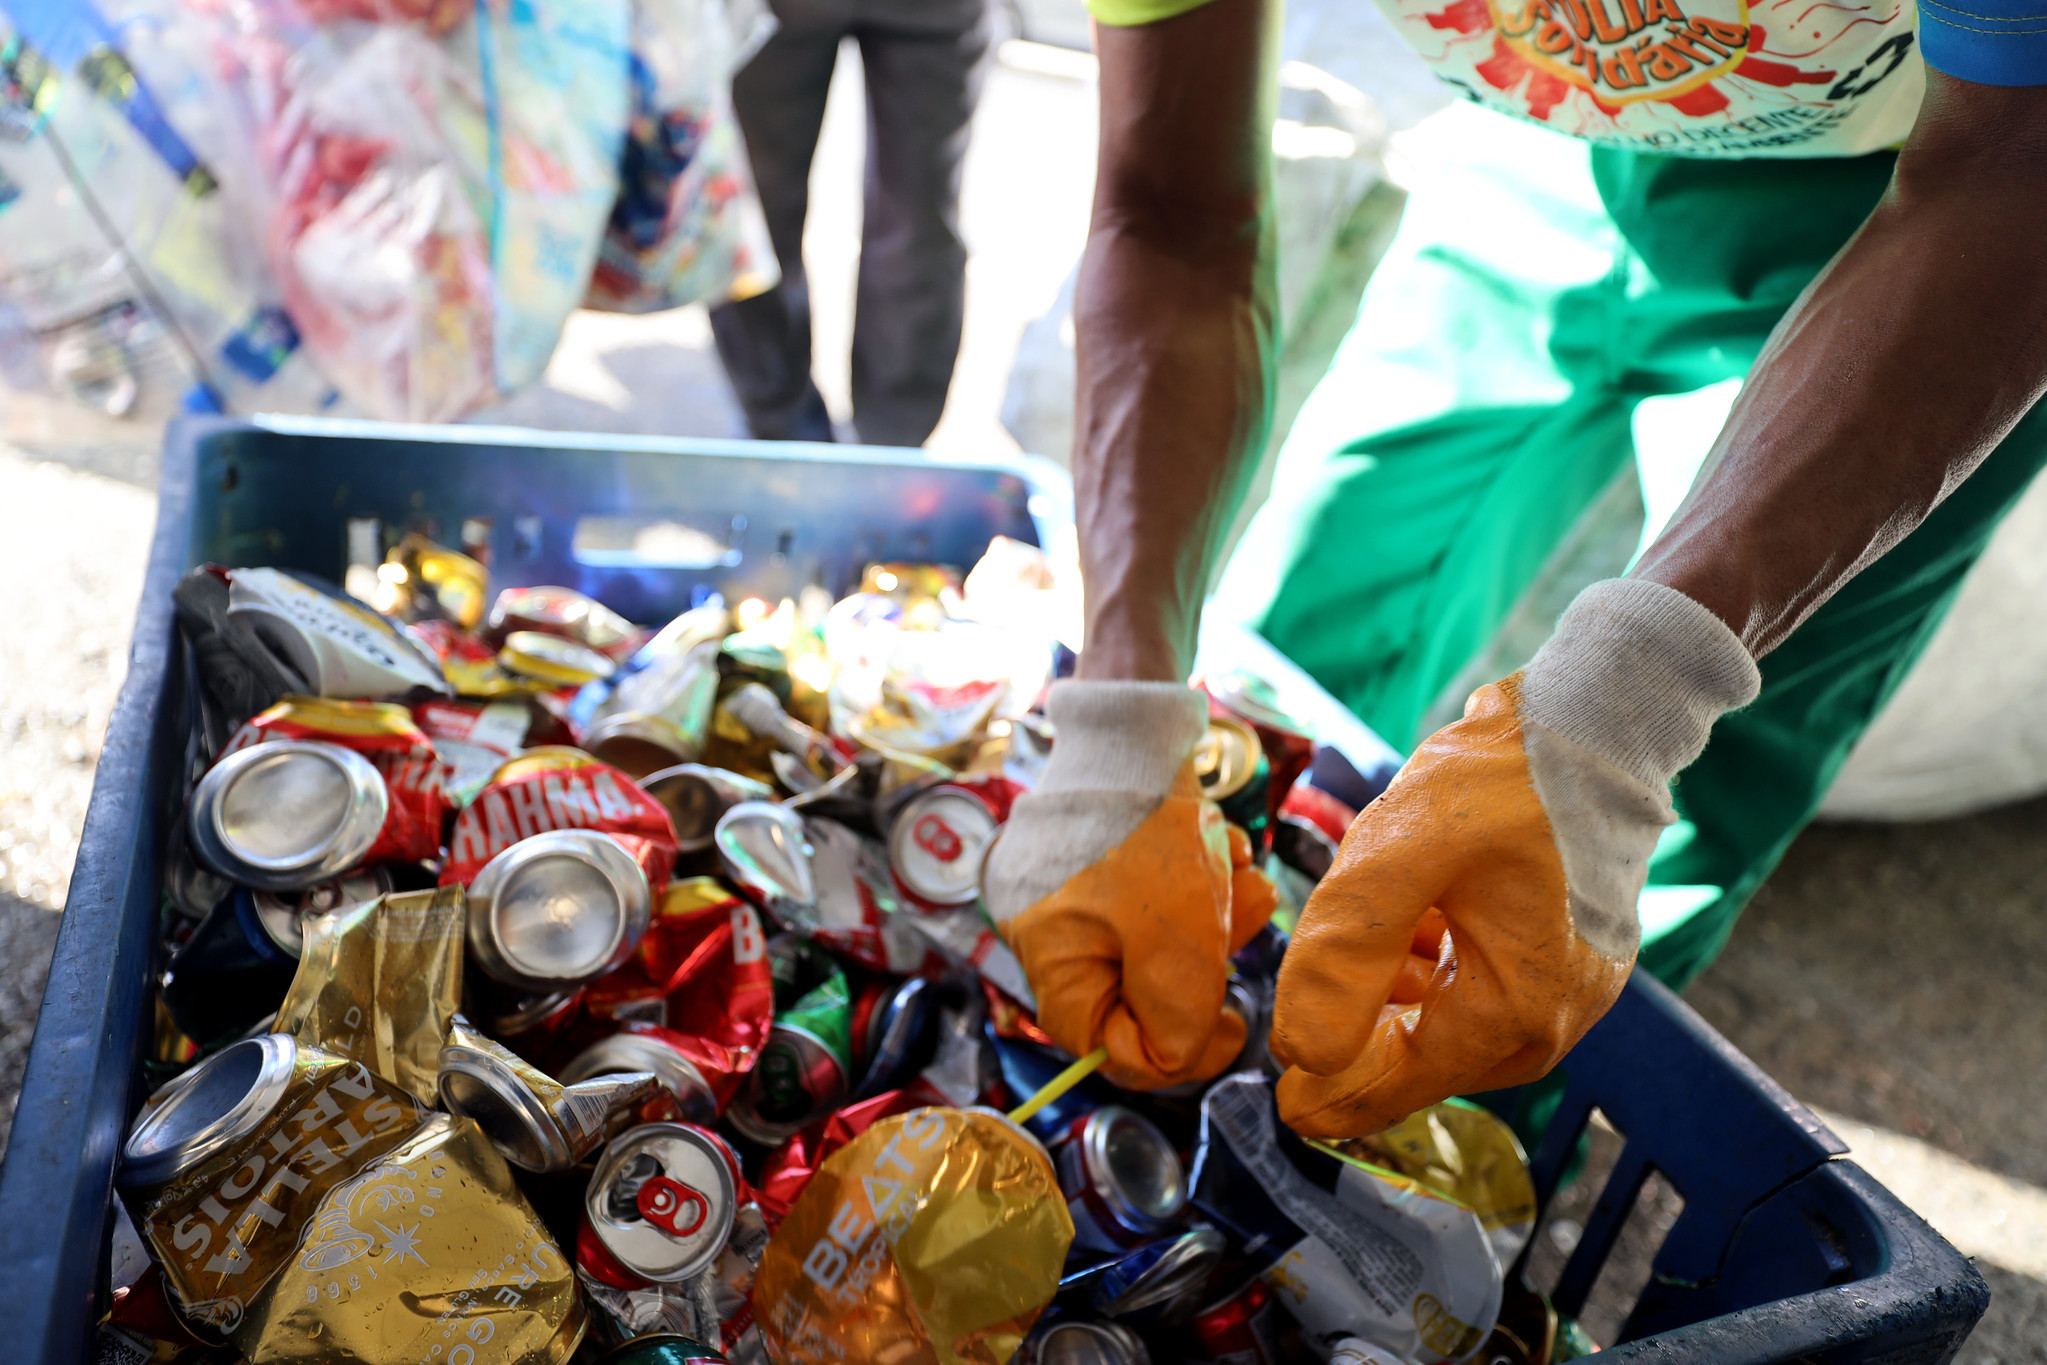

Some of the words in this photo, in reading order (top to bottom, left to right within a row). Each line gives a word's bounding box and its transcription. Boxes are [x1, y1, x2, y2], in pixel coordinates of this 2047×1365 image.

[334, 1005, 362, 1058] LD
[172, 1061, 376, 1260] ARTOIS
[203, 1093, 402, 1275] STELLA
[801, 1107, 946, 1292] BEATS
[305, 1264, 379, 1303] 1366
[466, 1267, 489, 1290] SEM
[493, 1235, 560, 1309] URE
